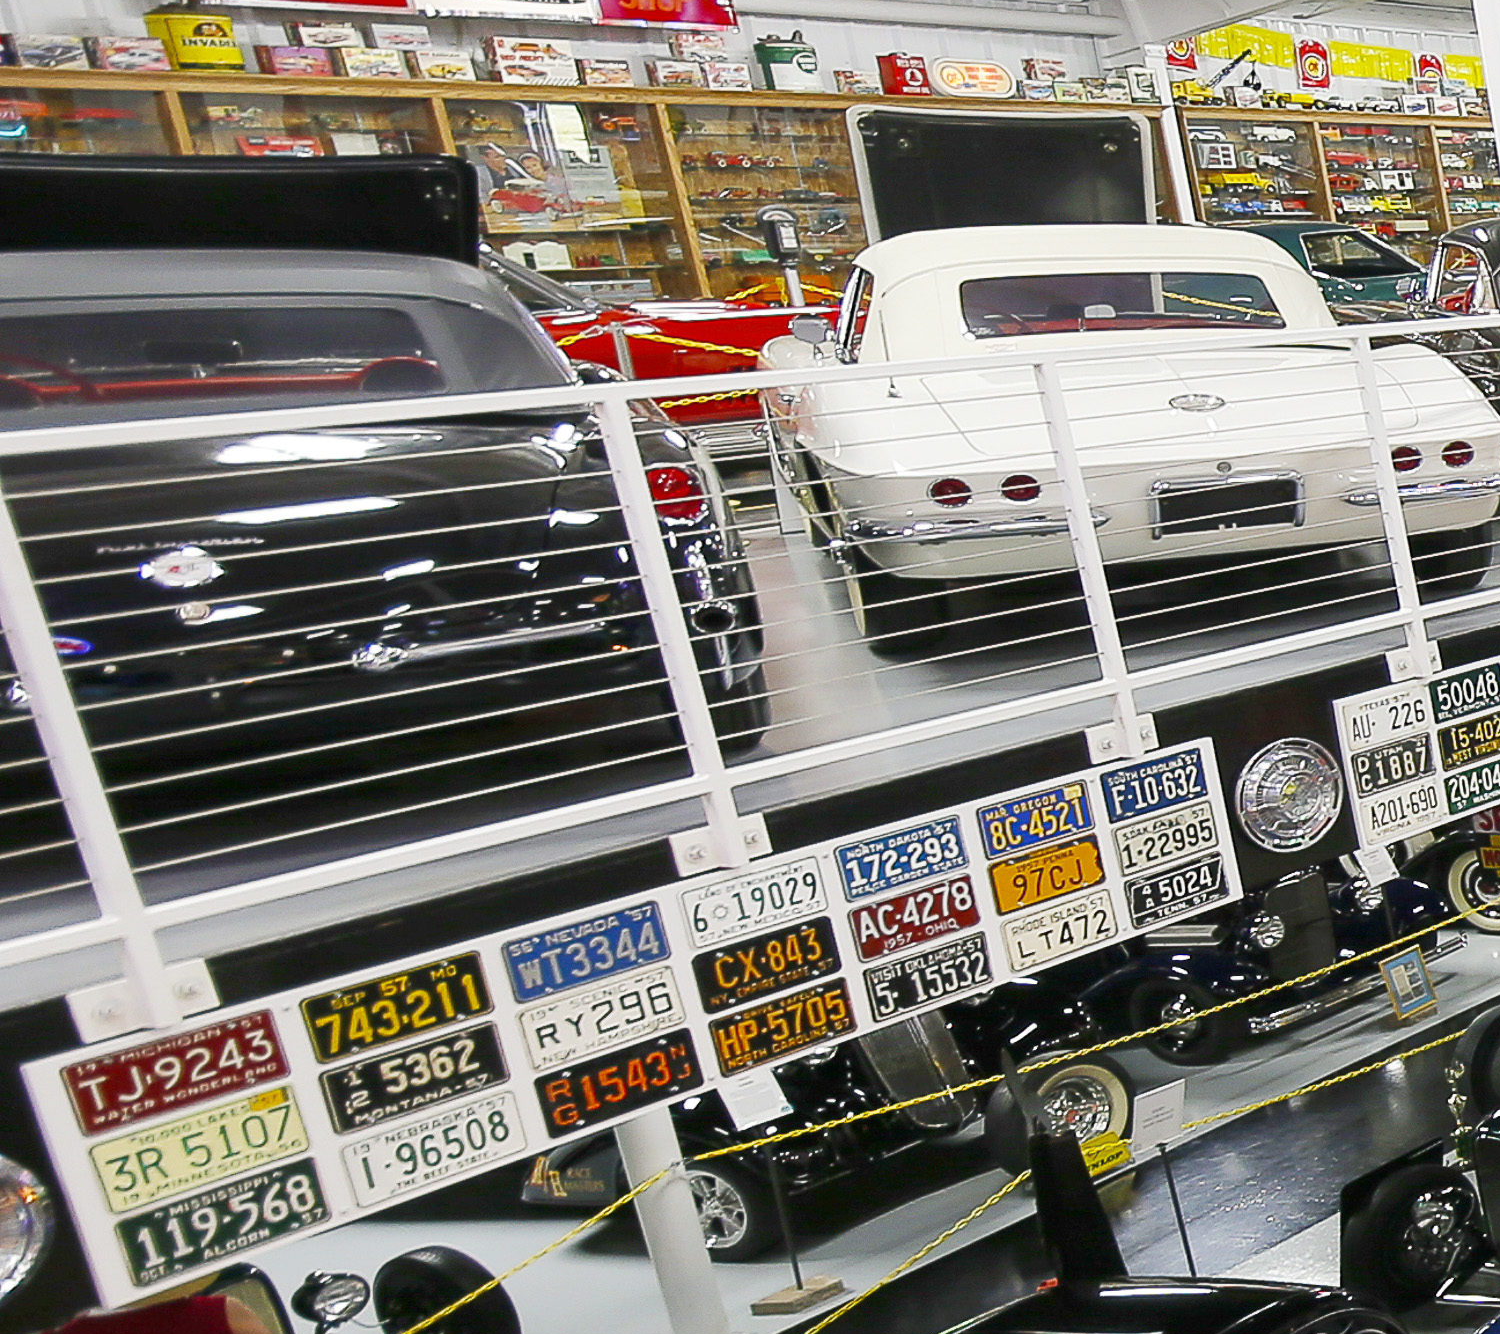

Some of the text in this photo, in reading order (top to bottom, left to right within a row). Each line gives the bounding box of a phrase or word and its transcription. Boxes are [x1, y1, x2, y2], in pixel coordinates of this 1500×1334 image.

[1437, 668, 1500, 712] 50048
[1389, 699, 1426, 730] 226
[1374, 745, 1405, 760] UTAH
[1377, 746, 1428, 785] 1887
[731, 872, 818, 922] 19029
[1012, 859, 1085, 901] 97CJ
[1159, 865, 1213, 899] 5024
[546, 916, 620, 945] NEVADA
[883, 917, 959, 950] 1957 OHIO
[1048, 904, 1088, 925] ISLAND
[516, 922, 661, 990] WT3344
[910, 950, 989, 1003] 15532
[120, 1028, 223, 1063] MICHIGAN
[579, 1015, 684, 1053] HAMPSHIRE
[379, 1038, 481, 1094] 5362
[580, 1051, 671, 1112] 1543
[106, 1106, 291, 1194] 3R 5107
[169, 1176, 270, 1218] MISSISSIPPI
[202, 1227, 271, 1260] ALCORN
